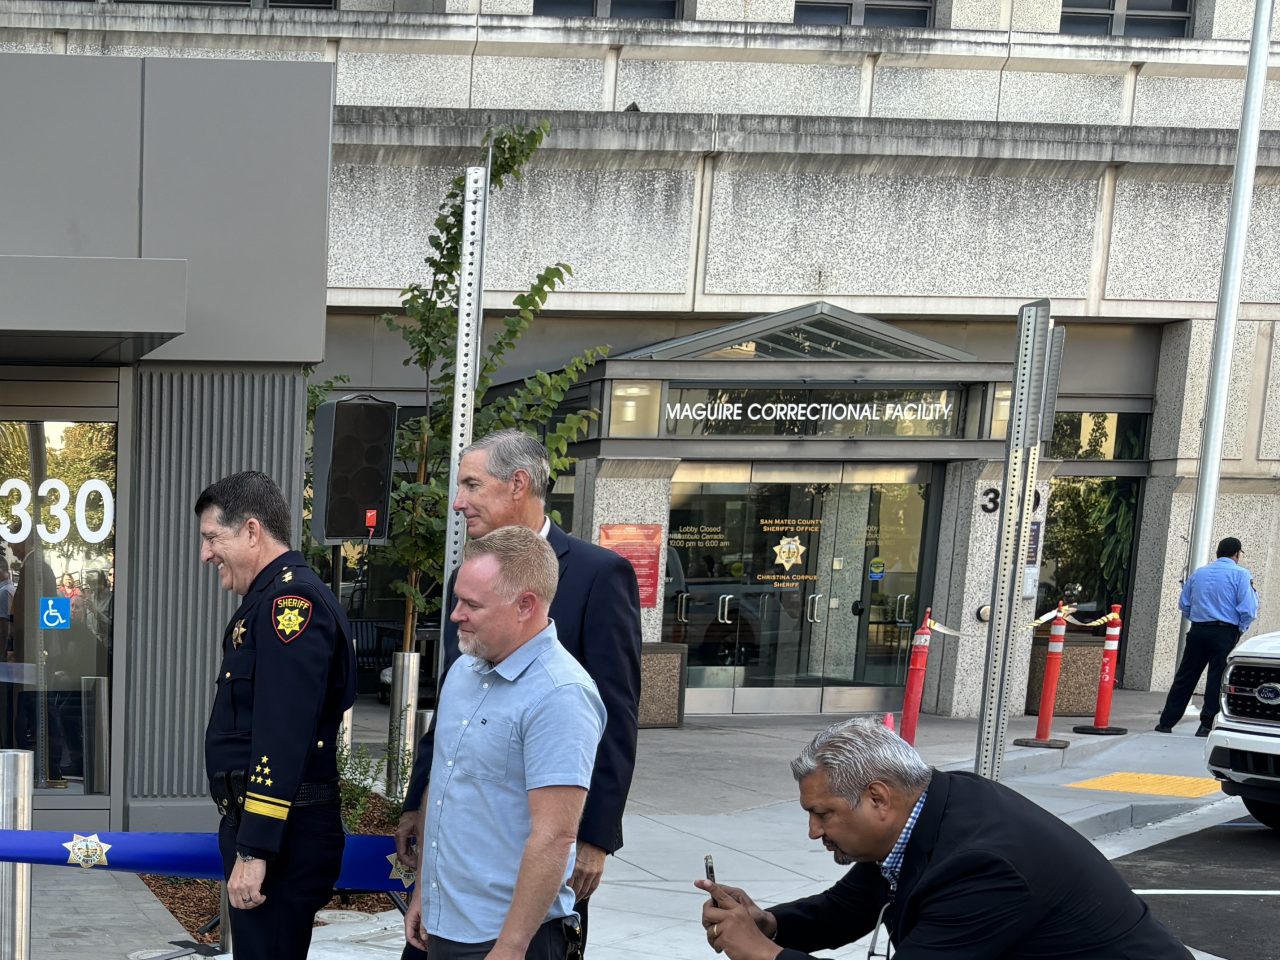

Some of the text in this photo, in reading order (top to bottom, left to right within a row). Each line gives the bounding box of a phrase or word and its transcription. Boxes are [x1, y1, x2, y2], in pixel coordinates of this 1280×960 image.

[665, 403, 953, 420] MAGUIRE CORRECTIONAL FACILITY
[680, 526, 698, 534] Lobby
[277, 598, 309, 609] SHERIFF
